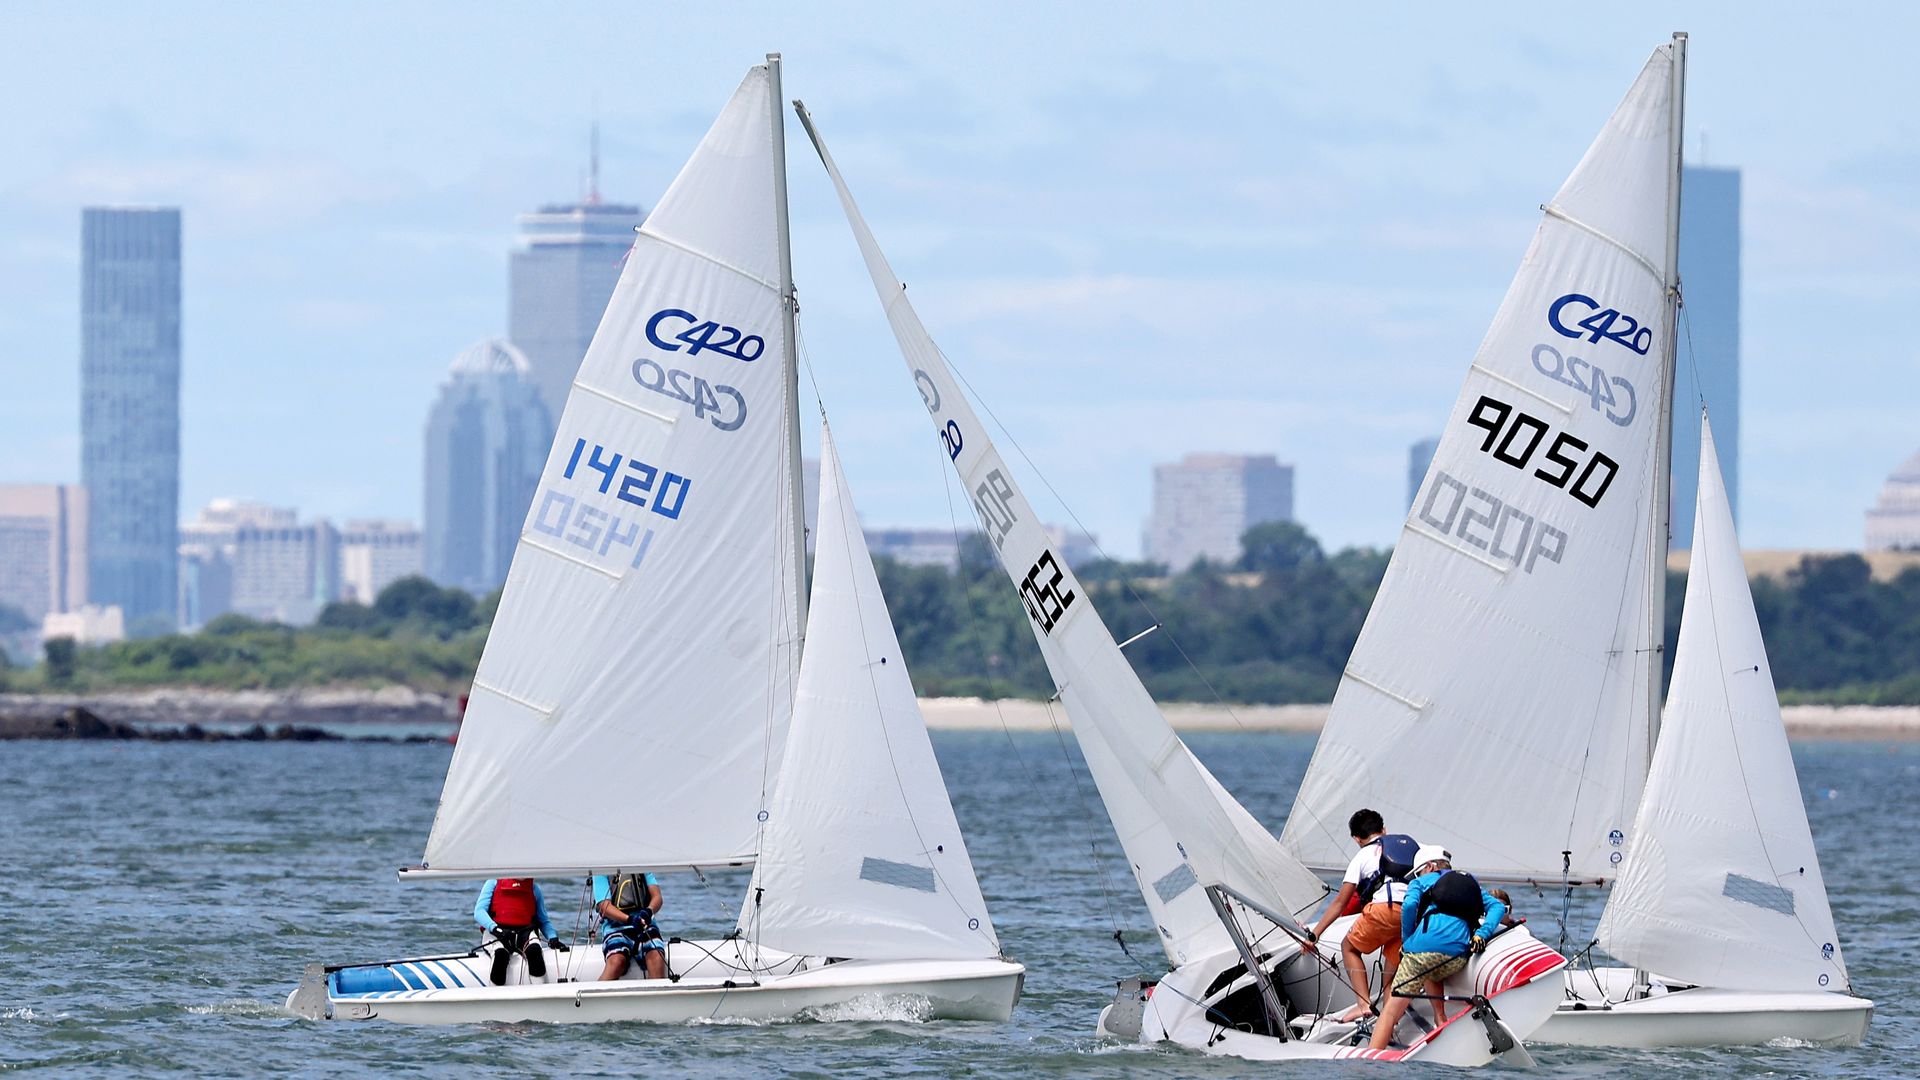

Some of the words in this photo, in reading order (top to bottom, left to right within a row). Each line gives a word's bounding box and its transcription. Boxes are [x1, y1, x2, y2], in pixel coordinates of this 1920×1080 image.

[645, 309, 765, 362] C420
[1548, 293, 1652, 356] C420
[563, 437, 691, 520] 1420
[1467, 395, 1620, 509] 9050
